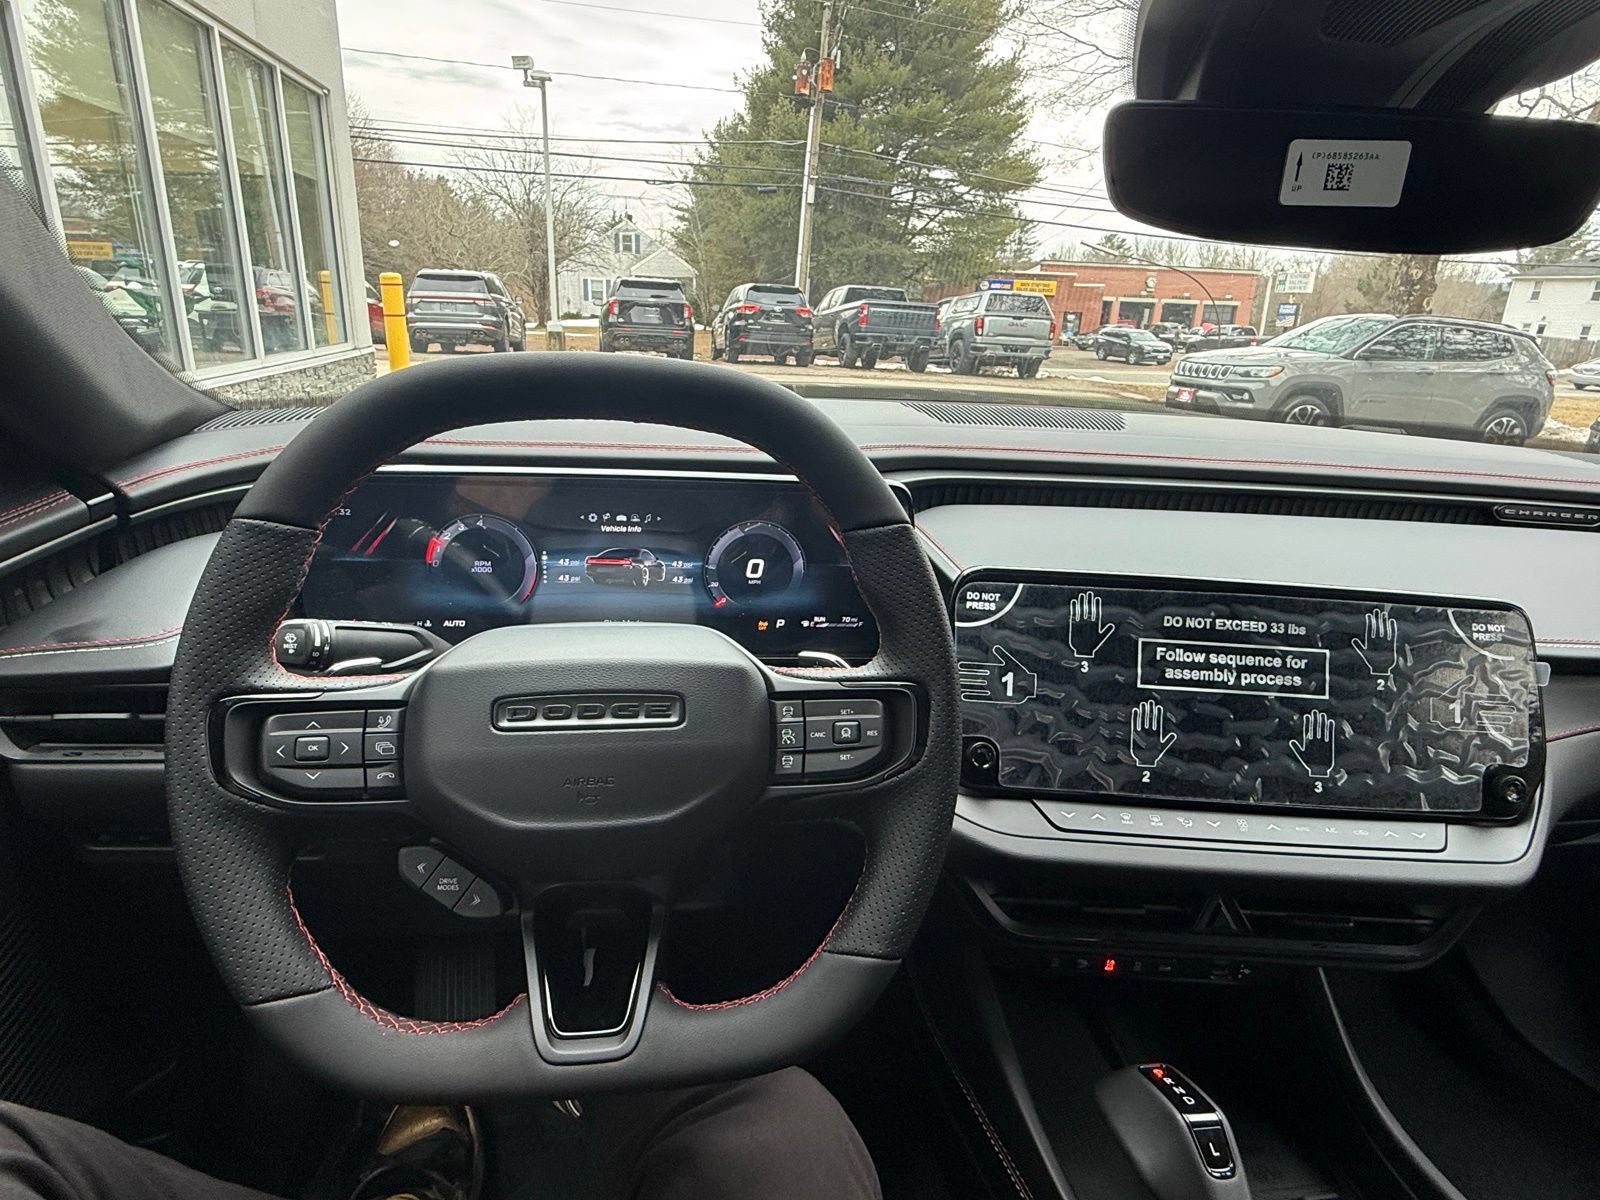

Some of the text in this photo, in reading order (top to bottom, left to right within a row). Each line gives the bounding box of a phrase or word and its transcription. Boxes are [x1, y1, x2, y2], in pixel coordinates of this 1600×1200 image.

[1504, 509, 1599, 519] CHARGER
[601, 525, 642, 533] Vehicle Info
[671, 560, 684, 568] 43
[746, 558, 765, 579] 0
[557, 574, 581, 583] 43 psi
[672, 575, 694, 584] 43 psi
[966, 591, 1001, 602] DO NOT
[965, 601, 996, 611] PRESS
[775, 619, 786, 629] P
[1163, 615, 1307, 635] DO NOT EXCEED 33 lbs
[1471, 623, 1506, 633] DO NOT
[1472, 632, 1503, 642] PRESS
[1156, 647, 1308, 669] Follow sequence for
[1080, 661, 1089, 673] 3
[1165, 667, 1303, 687] assembly process
[1001, 671, 1014, 697] 1
[1376, 678, 1385, 691] 2
[505, 702, 673, 722] DODGE
[1448, 699, 1461, 724] 1
[562, 776, 615, 788] AIRBAG
[1141, 770, 1151, 783] 2
[1313, 780, 1324, 793] 3
[1163, 1077, 1175, 1085] R
[1172, 1086, 1186, 1094] N
[1182, 1096, 1196, 1105] D
[1208, 1142, 1220, 1157] L
